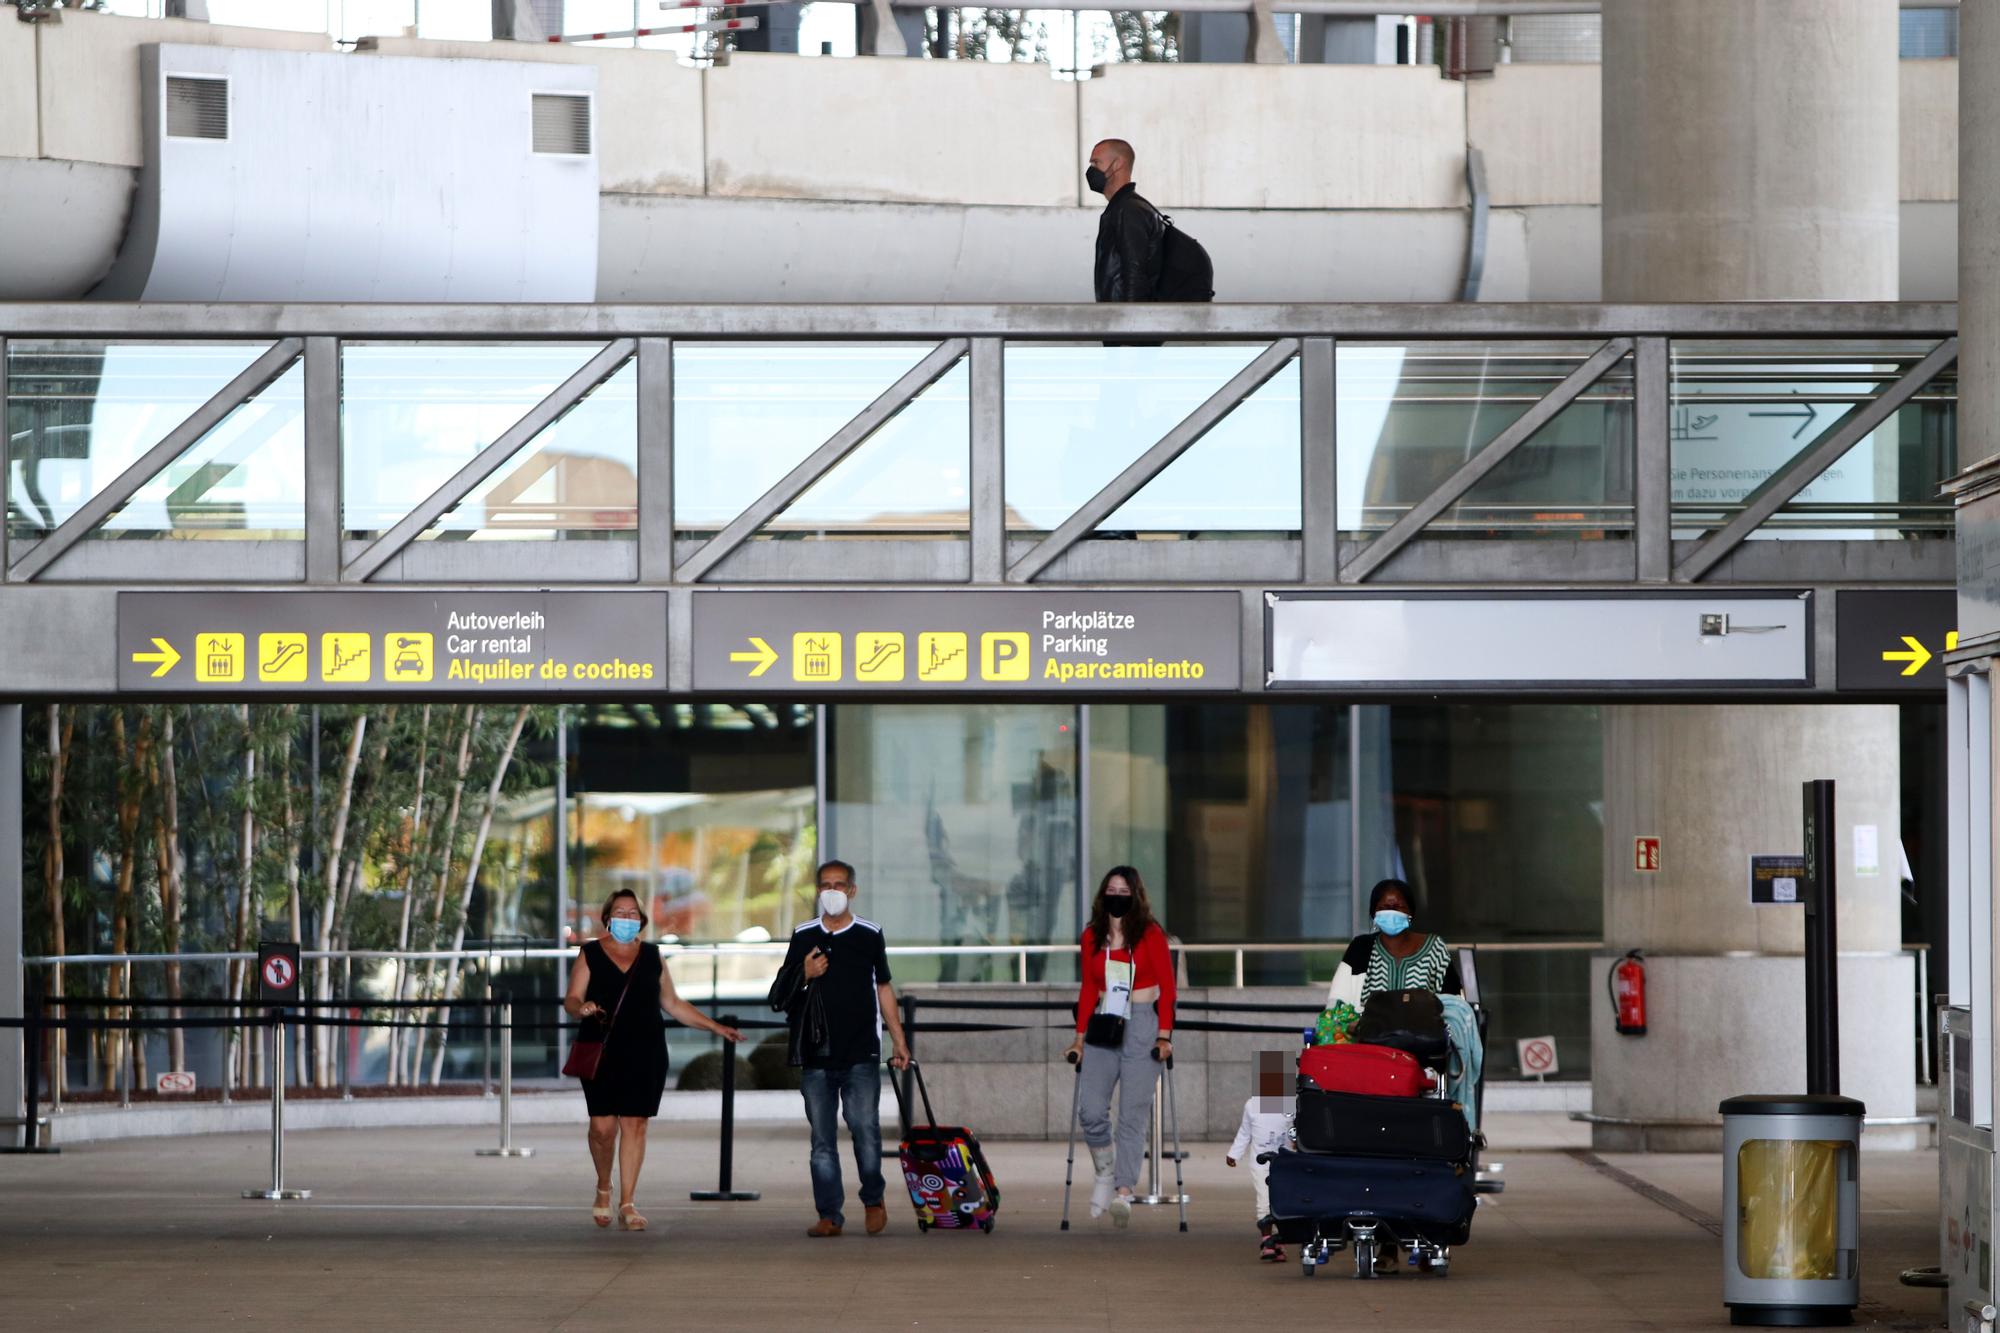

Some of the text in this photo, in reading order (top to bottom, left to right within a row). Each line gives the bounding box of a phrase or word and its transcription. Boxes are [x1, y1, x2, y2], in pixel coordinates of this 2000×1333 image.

[1687, 487, 1716, 498] dazu
[447, 611, 545, 630] Autoverleih
[1042, 610, 1135, 632] Parkplätze
[447, 634, 531, 653] Car rental
[1042, 634, 1108, 656] Parking
[993, 639, 1018, 674] P
[447, 658, 654, 684] Alquiler de coches
[1043, 657, 1204, 683] Aparcamiento
